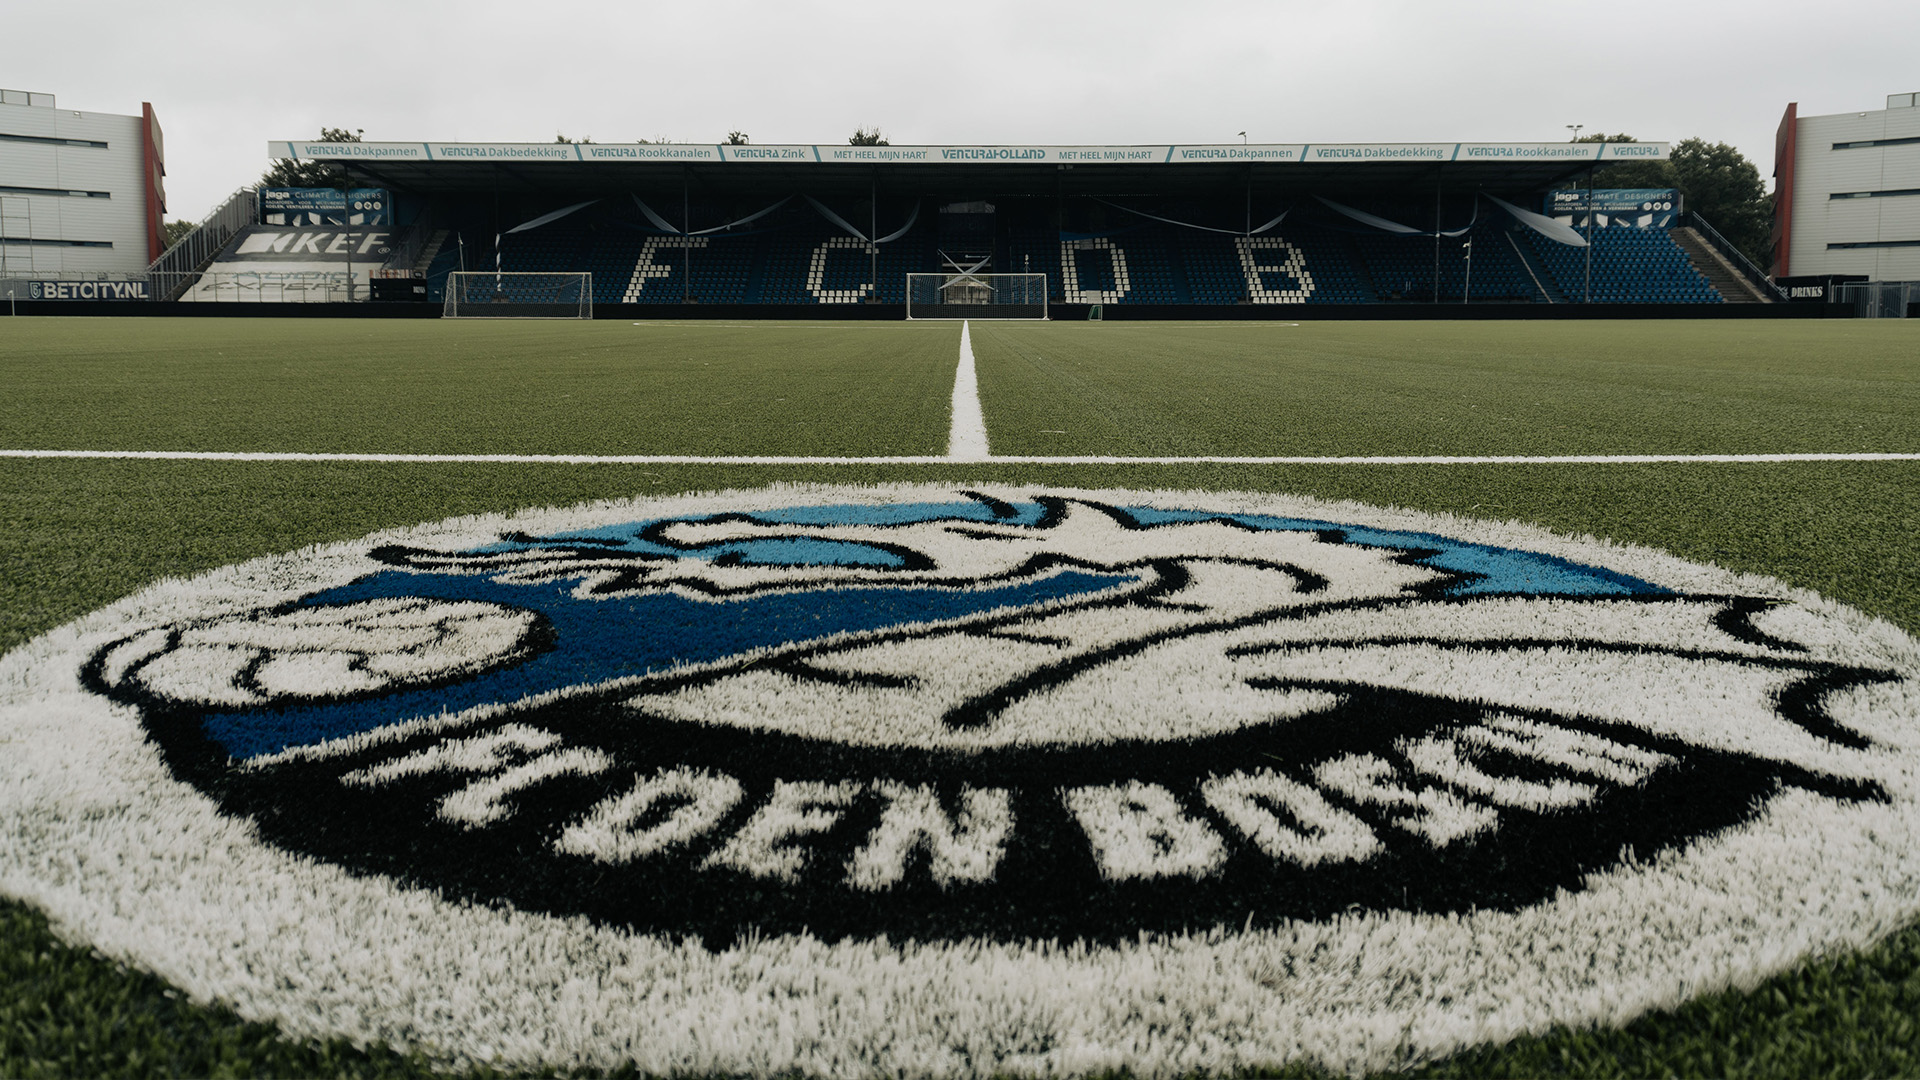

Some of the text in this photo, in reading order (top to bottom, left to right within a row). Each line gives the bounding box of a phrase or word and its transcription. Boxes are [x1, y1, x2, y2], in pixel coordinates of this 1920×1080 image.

[305, 146, 417, 159] VENTURA Dakpannen
[440, 147, 567, 160] VENTURA Dakbedekking
[591, 148, 711, 158] VENTURA Rookkanalen
[733, 149, 805, 159] VENTURA Zink
[834, 150, 927, 161] MET HEEL MIJN HART
[1059, 151, 1152, 161] MET HEEL MIJN HART
[1181, 149, 1293, 161] VENTURA Dakpannen
[1316, 148, 1443, 160] VENTURA Dakbedekking
[1467, 146, 1589, 157] VENTURA Rookkanalen
[1613, 146, 1660, 156] VENTURA
[265, 189, 290, 200] jaga
[294, 191, 330, 199] CLIMATE
[1554, 191, 1579, 202] jaga
[1624, 192, 1673, 200] DESIGNERS
[43, 281, 149, 299] BETCITY.NL
[1790, 286, 1823, 298] DRINKS
[550, 763, 1017, 893] DEN
[1058, 708, 1681, 884] BOSCH
